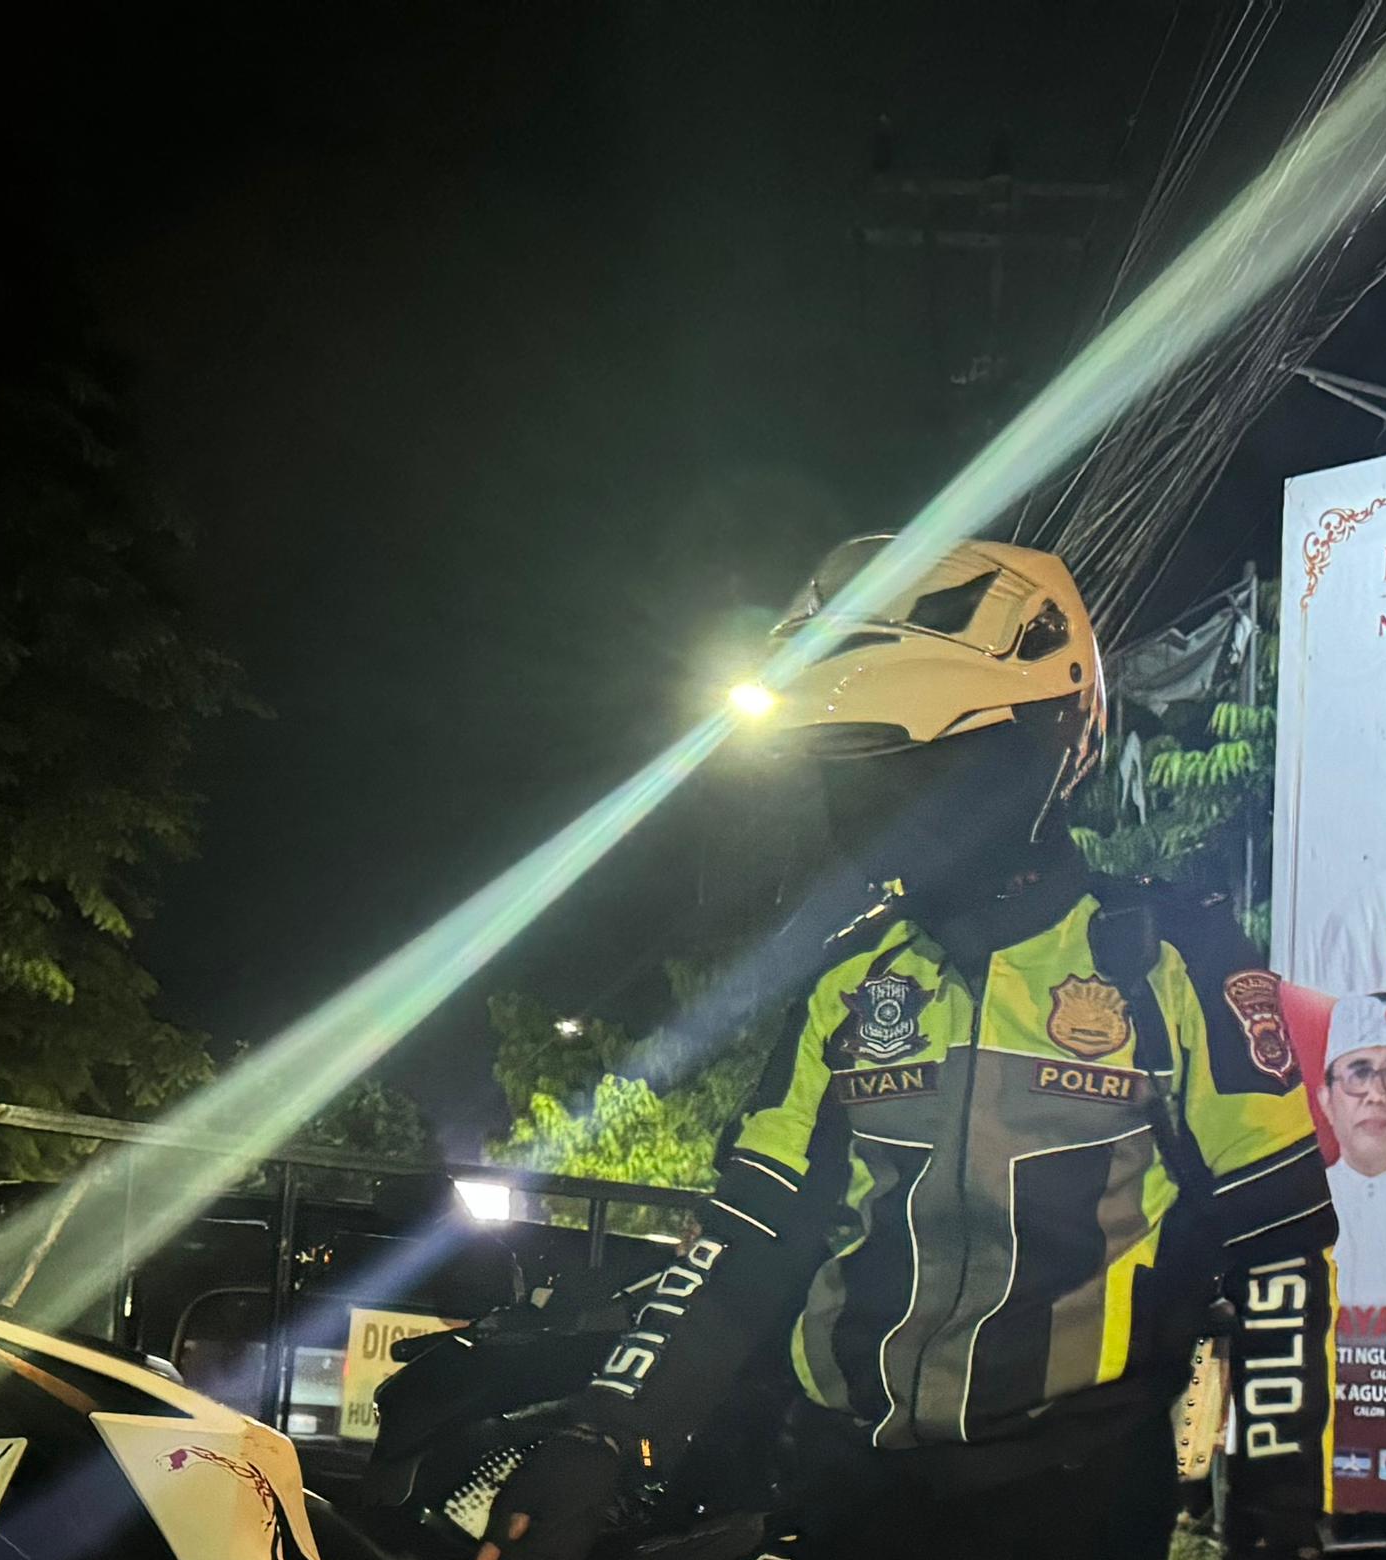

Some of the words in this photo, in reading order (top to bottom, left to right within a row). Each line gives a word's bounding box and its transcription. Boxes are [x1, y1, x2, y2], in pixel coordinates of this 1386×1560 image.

[848, 1067, 924, 1100] IVAN
[1038, 1065, 1133, 1099] POLRI
[1244, 1256, 1308, 1460] POLISI
[1337, 1348, 1352, 1363] TI
[1336, 1384, 1348, 1400] K
